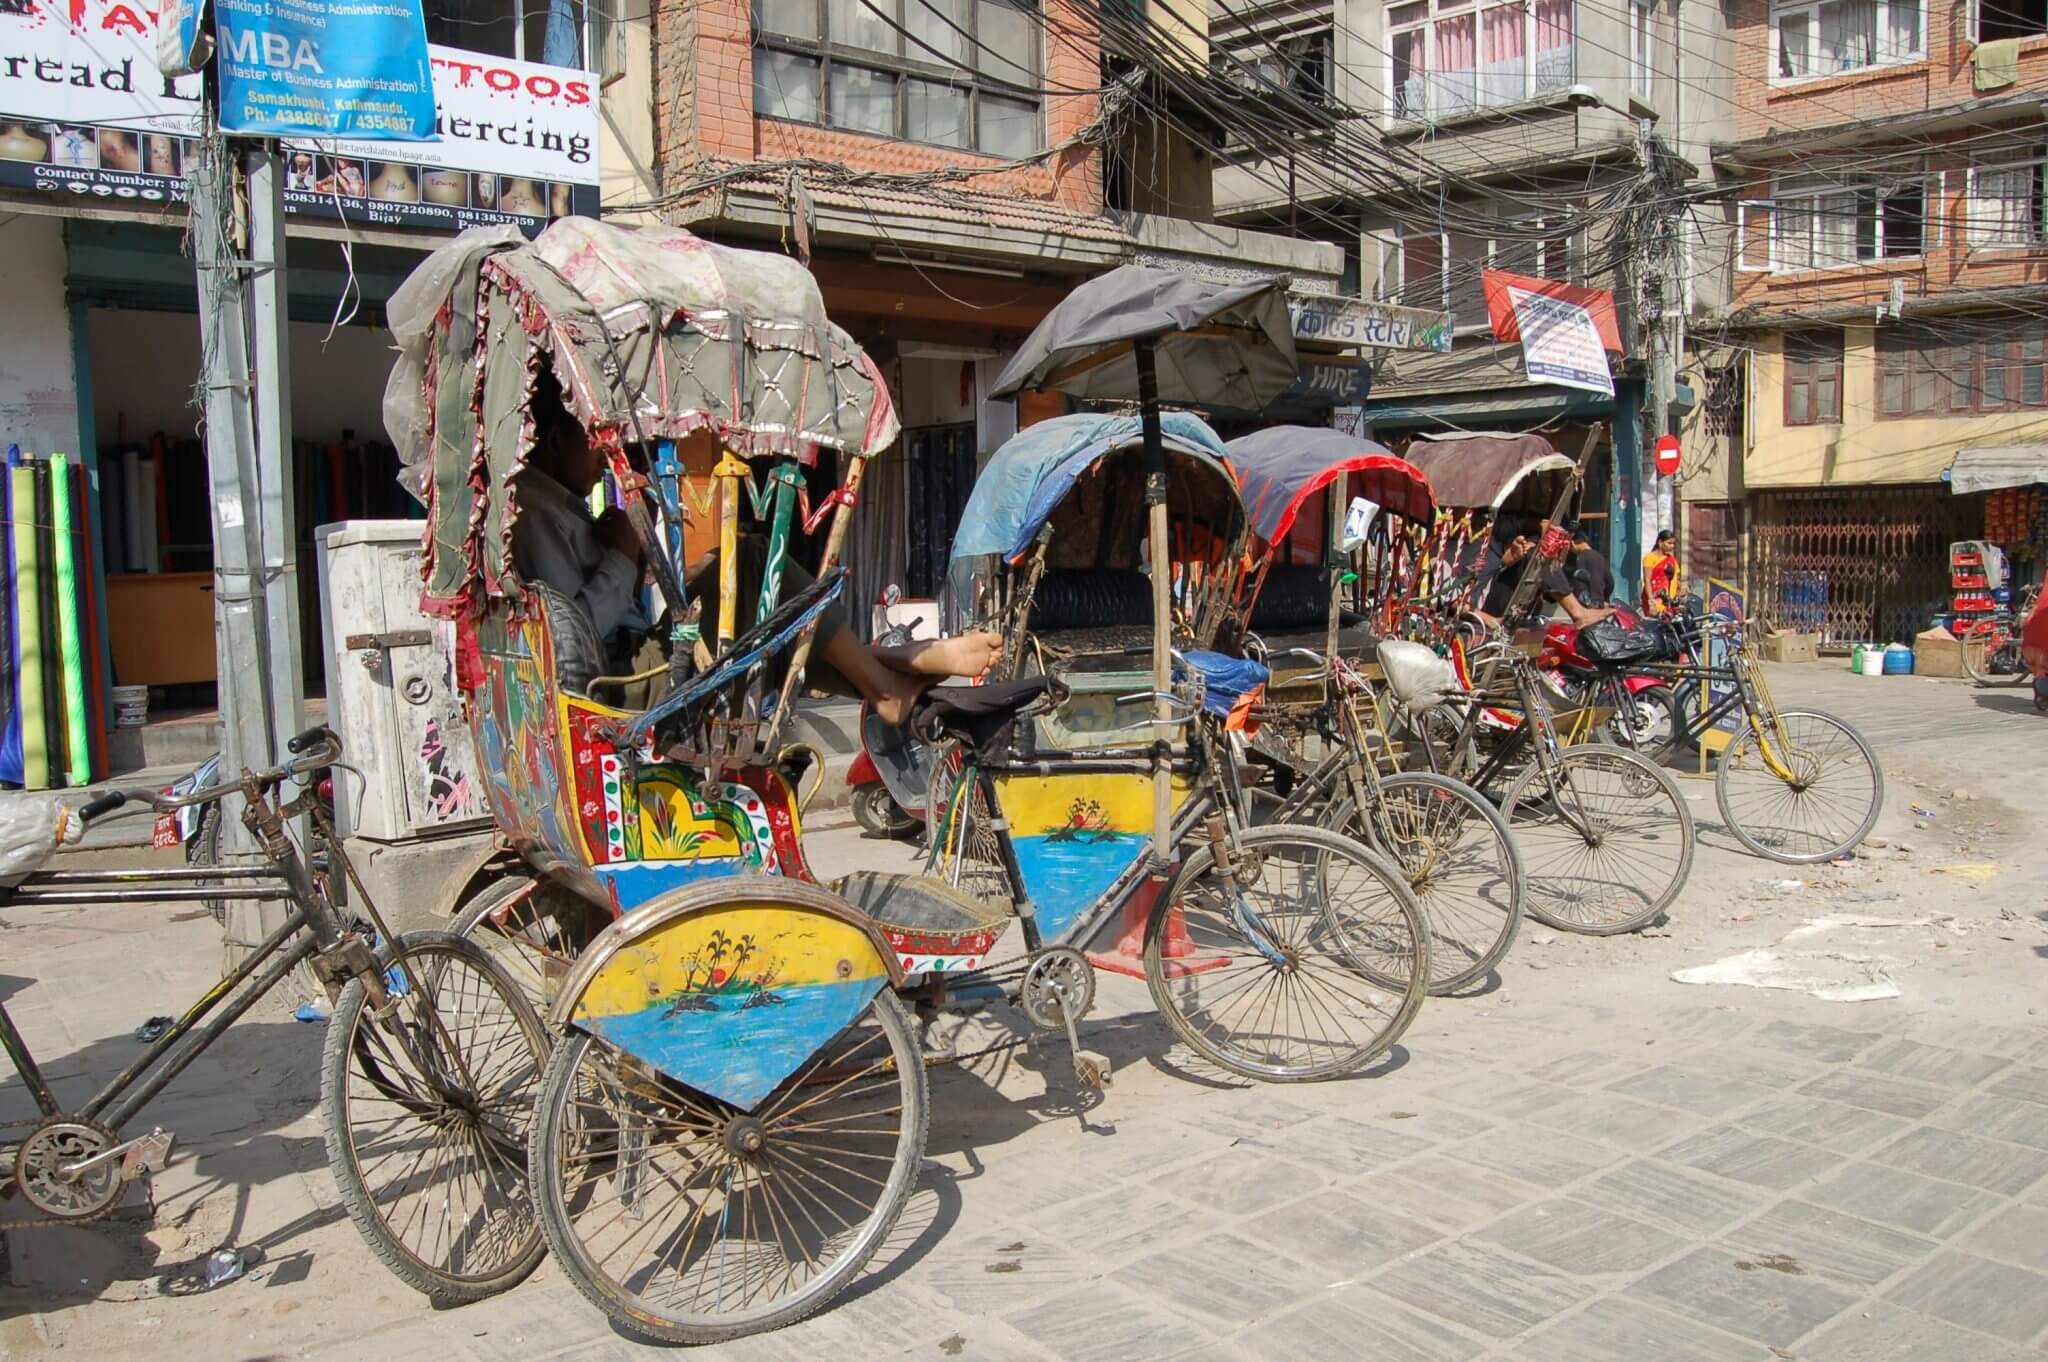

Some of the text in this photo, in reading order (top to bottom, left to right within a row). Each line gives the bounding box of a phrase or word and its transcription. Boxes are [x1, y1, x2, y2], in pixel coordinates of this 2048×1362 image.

[219, 26, 325, 74] MBA
[272, 71, 283, 81] of
[285, 71, 333, 89] Business
[336, 77, 418, 95] Administration)
[244, 105, 270, 122] Ph:
[34, 166, 95, 181] Contact
[100, 173, 165, 188] Number:
[368, 201, 455, 219] 9807220890,
[457, 210, 535, 226] 9813837359
[368, 210, 402, 224] Bijay
[1310, 364, 1359, 398] HIRE
